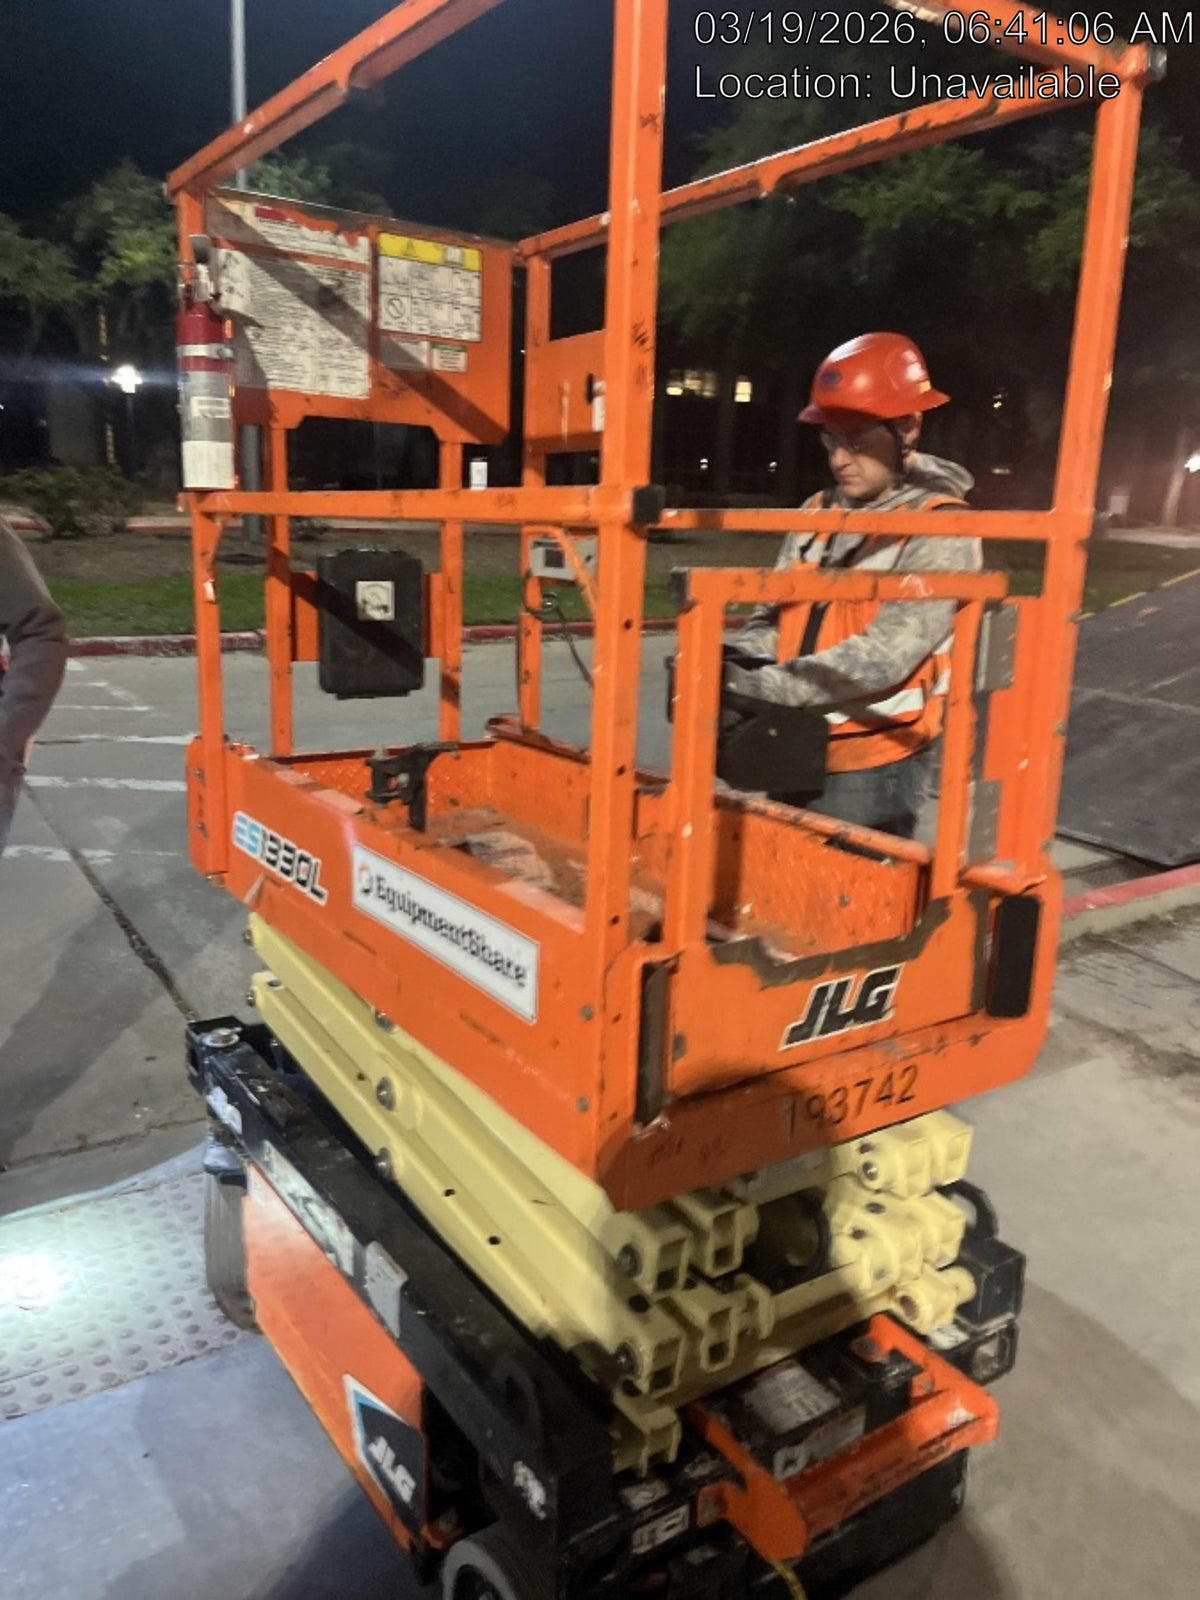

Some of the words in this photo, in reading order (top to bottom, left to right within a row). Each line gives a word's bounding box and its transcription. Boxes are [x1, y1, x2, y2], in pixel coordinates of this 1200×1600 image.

[233, 812, 326, 904] ES1330L
[374, 873, 528, 988] EquipmentShare
[780, 963, 902, 1050] JLG
